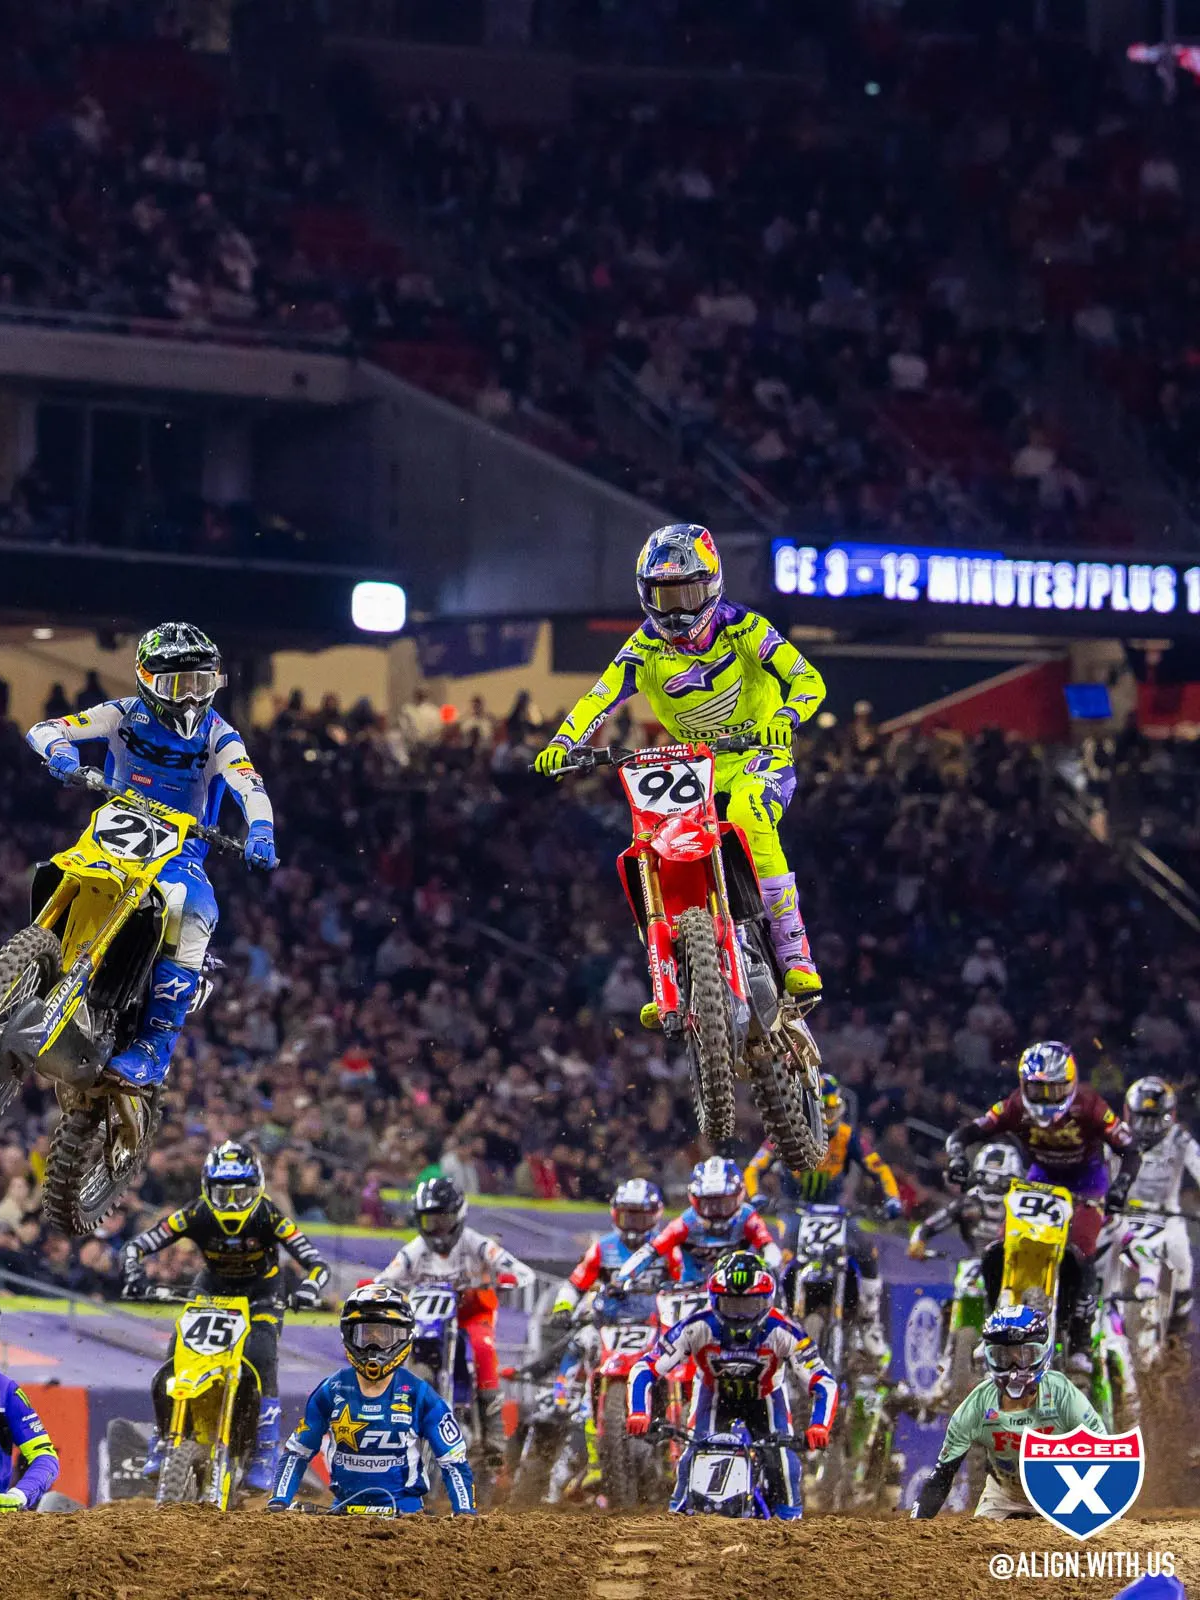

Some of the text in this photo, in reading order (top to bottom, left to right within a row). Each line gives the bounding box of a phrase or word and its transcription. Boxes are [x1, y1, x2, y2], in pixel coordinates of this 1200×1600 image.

[825, 549, 849, 597] 3
[881, 552, 920, 600] 12
[928, 555, 1177, 614] MINUTES/PLUS
[680, 719, 758, 740] HONDA
[638, 771, 706, 807] 96
[98, 814, 170, 858] 21
[650, 943, 665, 1001] DUNLOP
[1019, 1196, 1061, 1223] 94
[412, 1294, 451, 1315] 711
[672, 1297, 708, 1323] 17
[184, 1315, 237, 1346] 45
[612, 1330, 647, 1350] 12
[706, 1457, 735, 1496] 1
